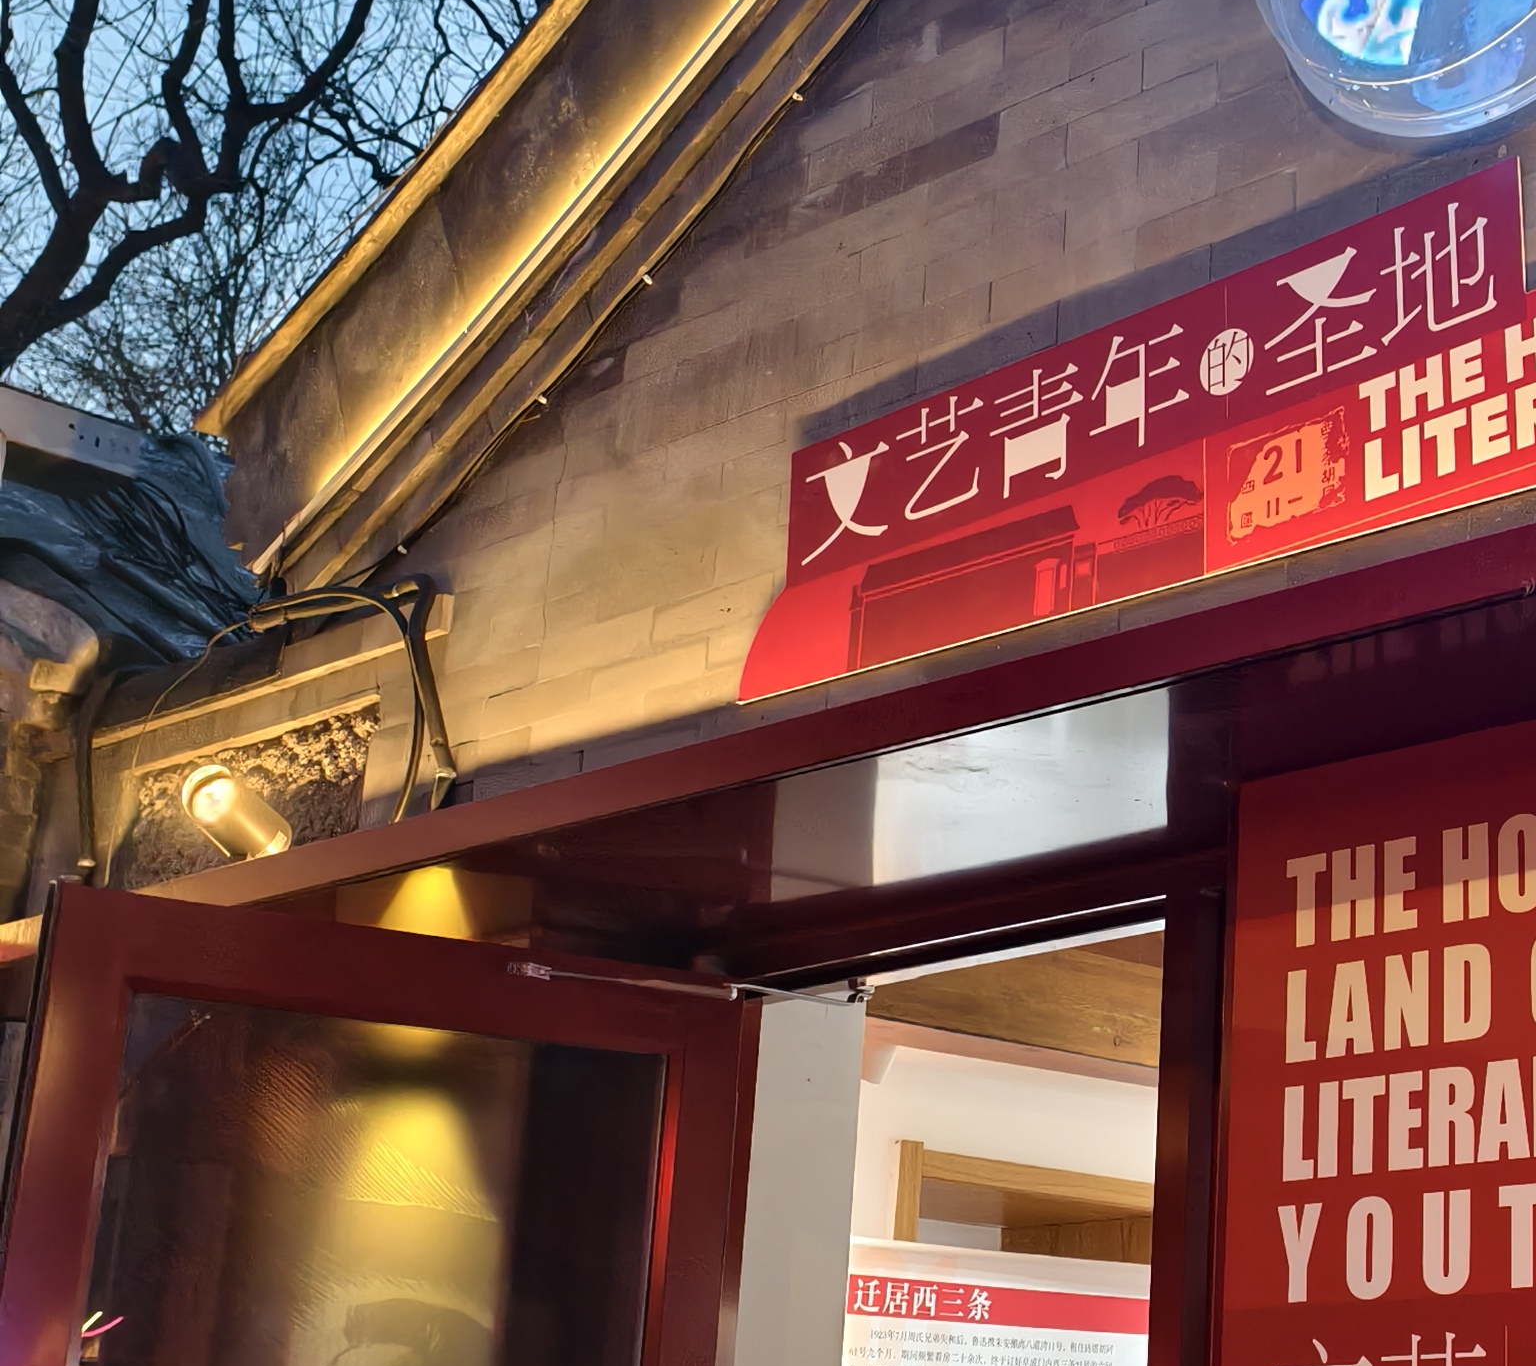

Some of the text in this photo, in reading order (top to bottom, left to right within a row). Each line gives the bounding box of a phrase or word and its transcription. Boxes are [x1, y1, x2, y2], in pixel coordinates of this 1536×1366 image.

[801, 202, 1497, 566] 文艺青年的圣地
[1358, 352, 1487, 433] THE
[1263, 439, 1302, 485] 21
[1286, 835, 1418, 948] THE
[1285, 943, 1491, 1063] LAND
[853, 1278, 992, 1321] 迁居西三条
